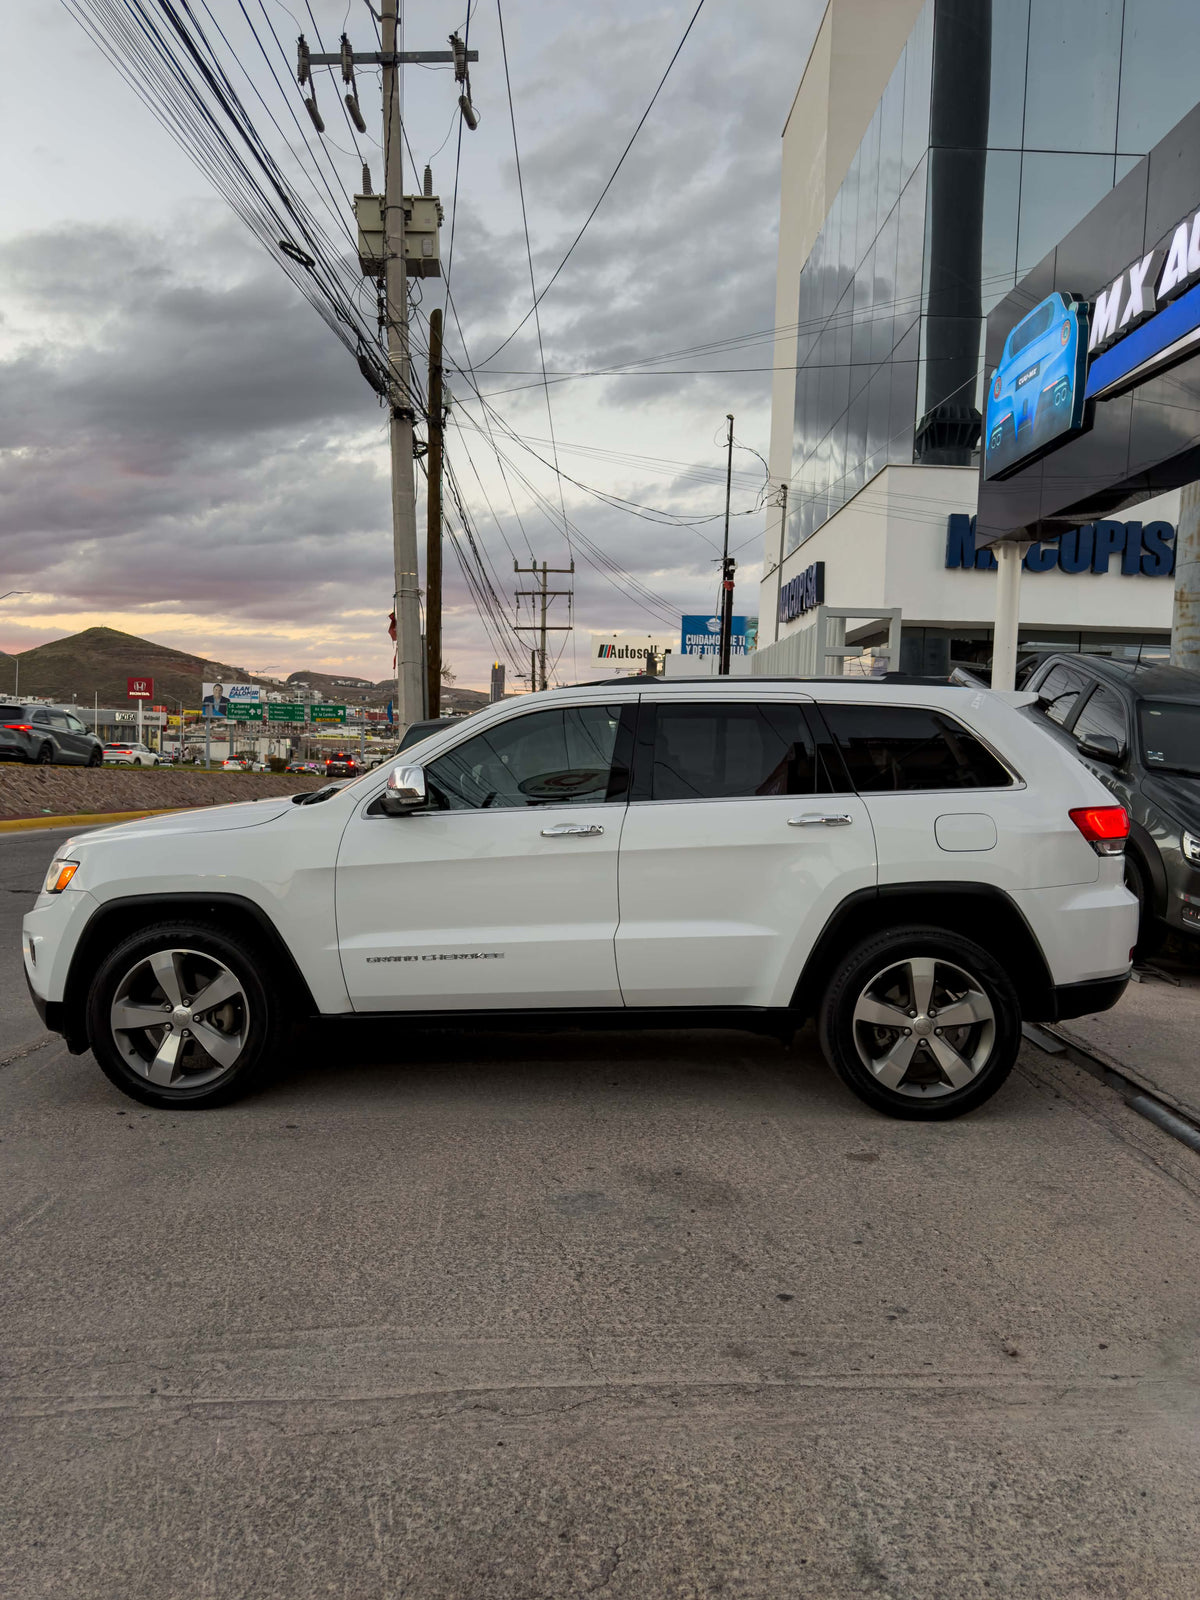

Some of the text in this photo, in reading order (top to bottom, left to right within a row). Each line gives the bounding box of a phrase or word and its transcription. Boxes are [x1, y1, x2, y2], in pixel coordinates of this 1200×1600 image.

[1088, 250, 1154, 353] MX
[946, 513, 1178, 577] MCOPIS
[685, 634, 721, 645] CUIDAMO
[739, 635, 746, 646] TI
[685, 645, 692, 656] Y
[692, 645, 703, 656] DE
[704, 645, 714, 656] TU
